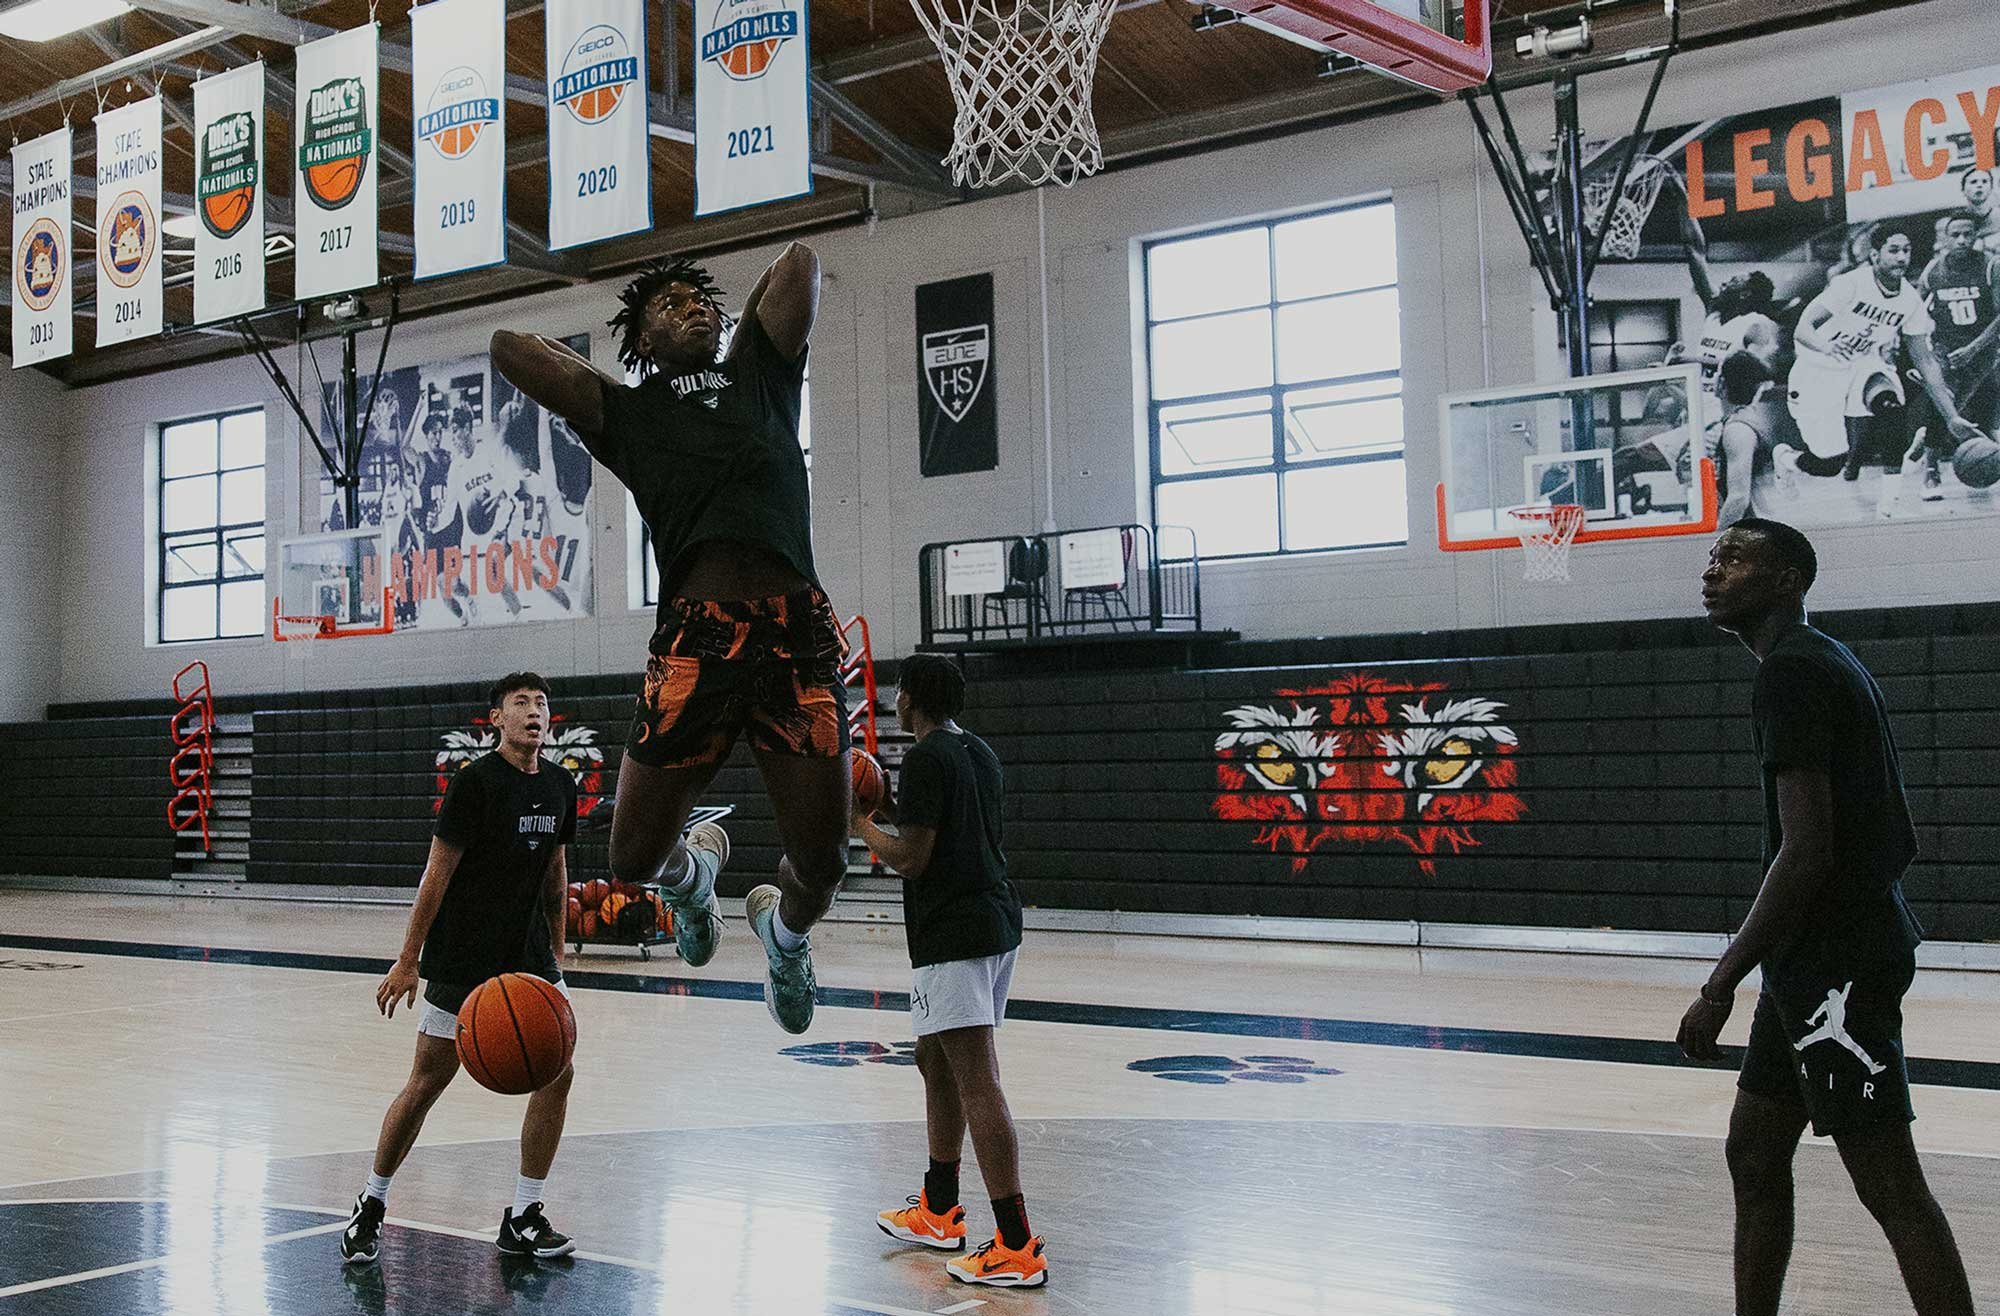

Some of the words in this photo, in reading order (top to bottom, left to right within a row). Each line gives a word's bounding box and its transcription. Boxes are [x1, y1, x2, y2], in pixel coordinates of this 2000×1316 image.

[578, 35, 614, 55] GEICO
[706, 14, 790, 54] NATIONALS
[555, 60, 631, 98] NATIONALS
[311, 80, 360, 118] DICK'S
[208, 114, 250, 151] DICK'S
[421, 100, 492, 135] NATIONALS
[114, 128, 142, 155] STATE
[306, 135, 362, 162] NATIONALS
[728, 125, 774, 158] 2021
[1685, 86, 2000, 220] LEGACY
[28, 159, 54, 185] STATE
[99, 151, 157, 186] CHAMPIONS
[202, 167, 254, 194] NATIONALS
[577, 164, 617, 198] 2020
[15, 180, 68, 214] CHAMPIONS
[440, 199, 475, 228] 2019
[320, 226, 352, 253] 2017
[214, 253, 242, 281] 2016
[115, 298, 142, 323] 2014
[29, 322, 54, 346] 2013
[670, 369, 733, 400] CULTURE
[940, 366, 974, 397] HS
[340, 534, 560, 606] HAMPIONS
[518, 815, 557, 834] CULTURE
[1800, 1062, 1875, 1100] AIR
